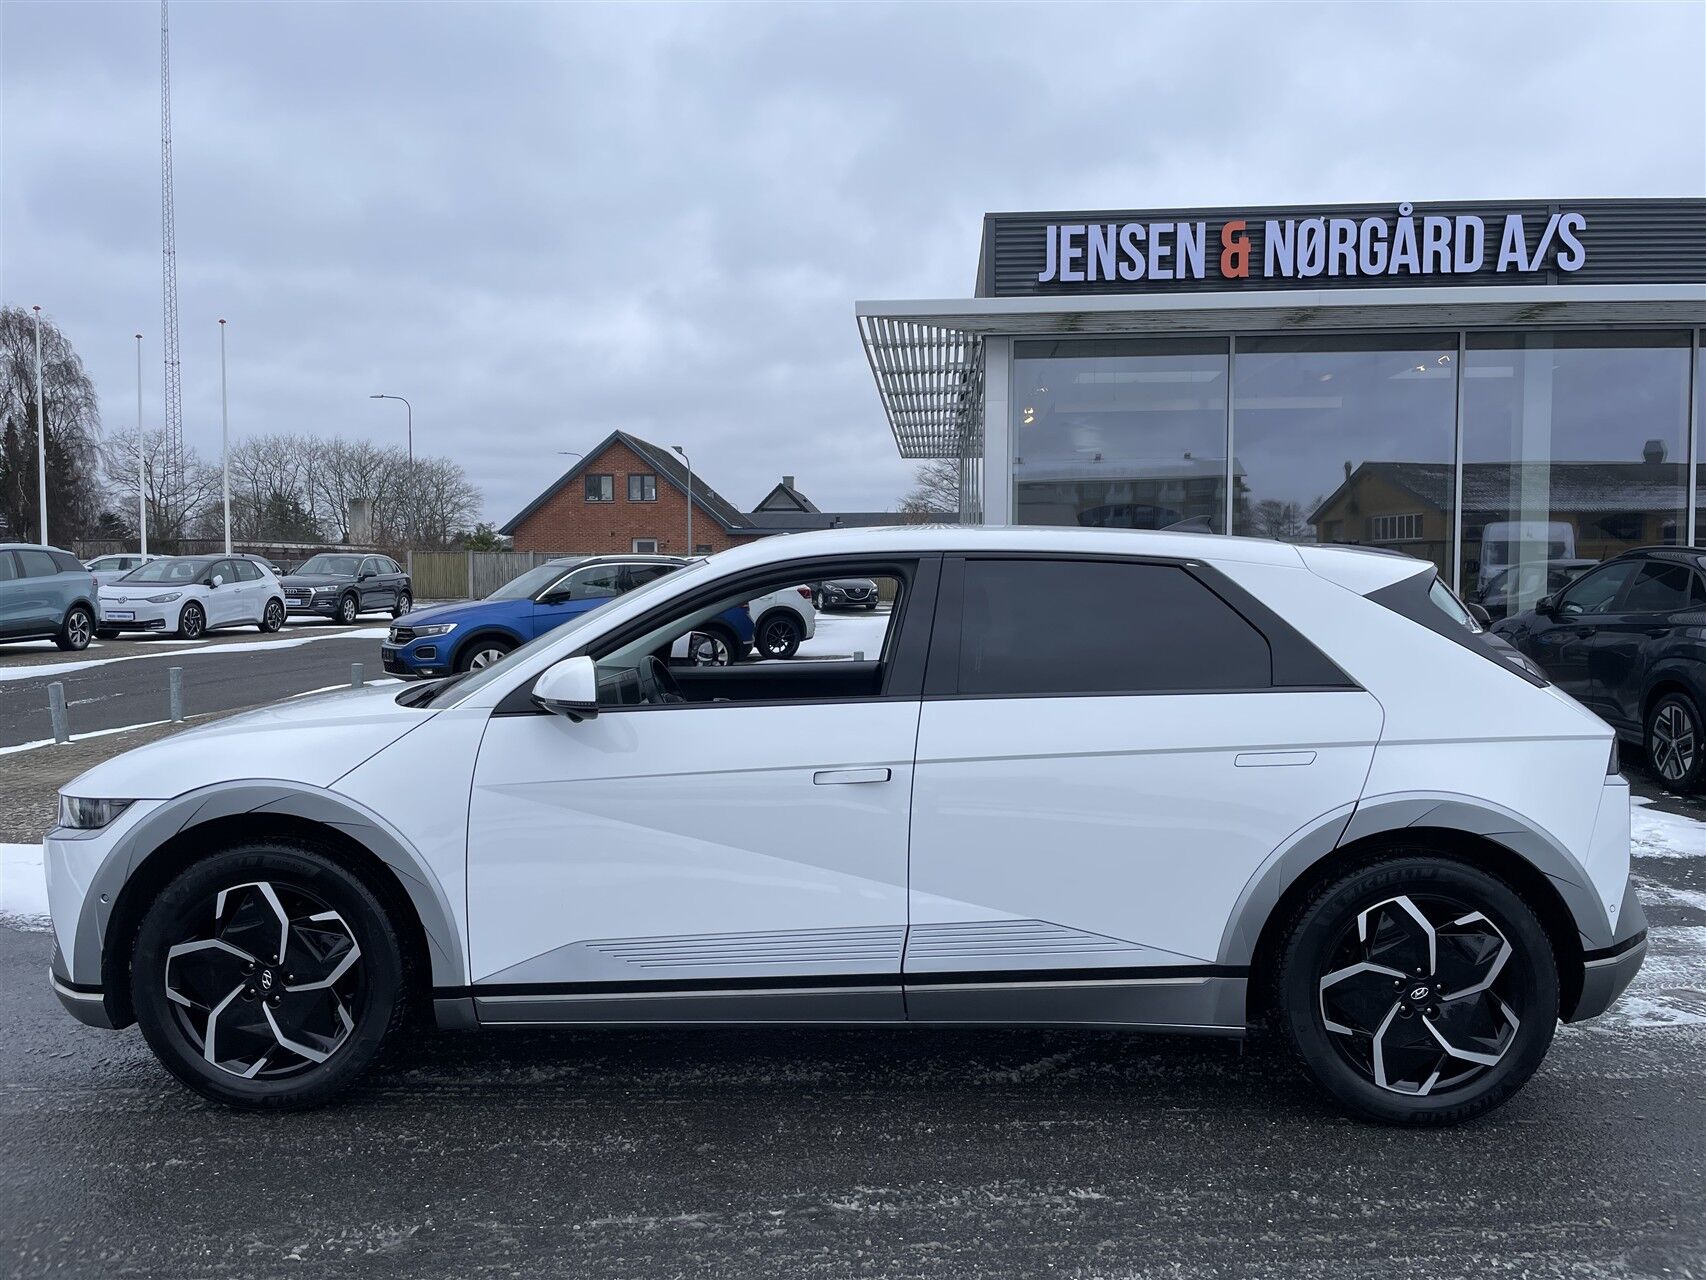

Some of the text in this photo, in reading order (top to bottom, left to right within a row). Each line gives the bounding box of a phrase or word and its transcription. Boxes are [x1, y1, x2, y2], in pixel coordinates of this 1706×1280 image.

[1038, 202, 1587, 282] JENSEN & NØRGÅRD A/S
